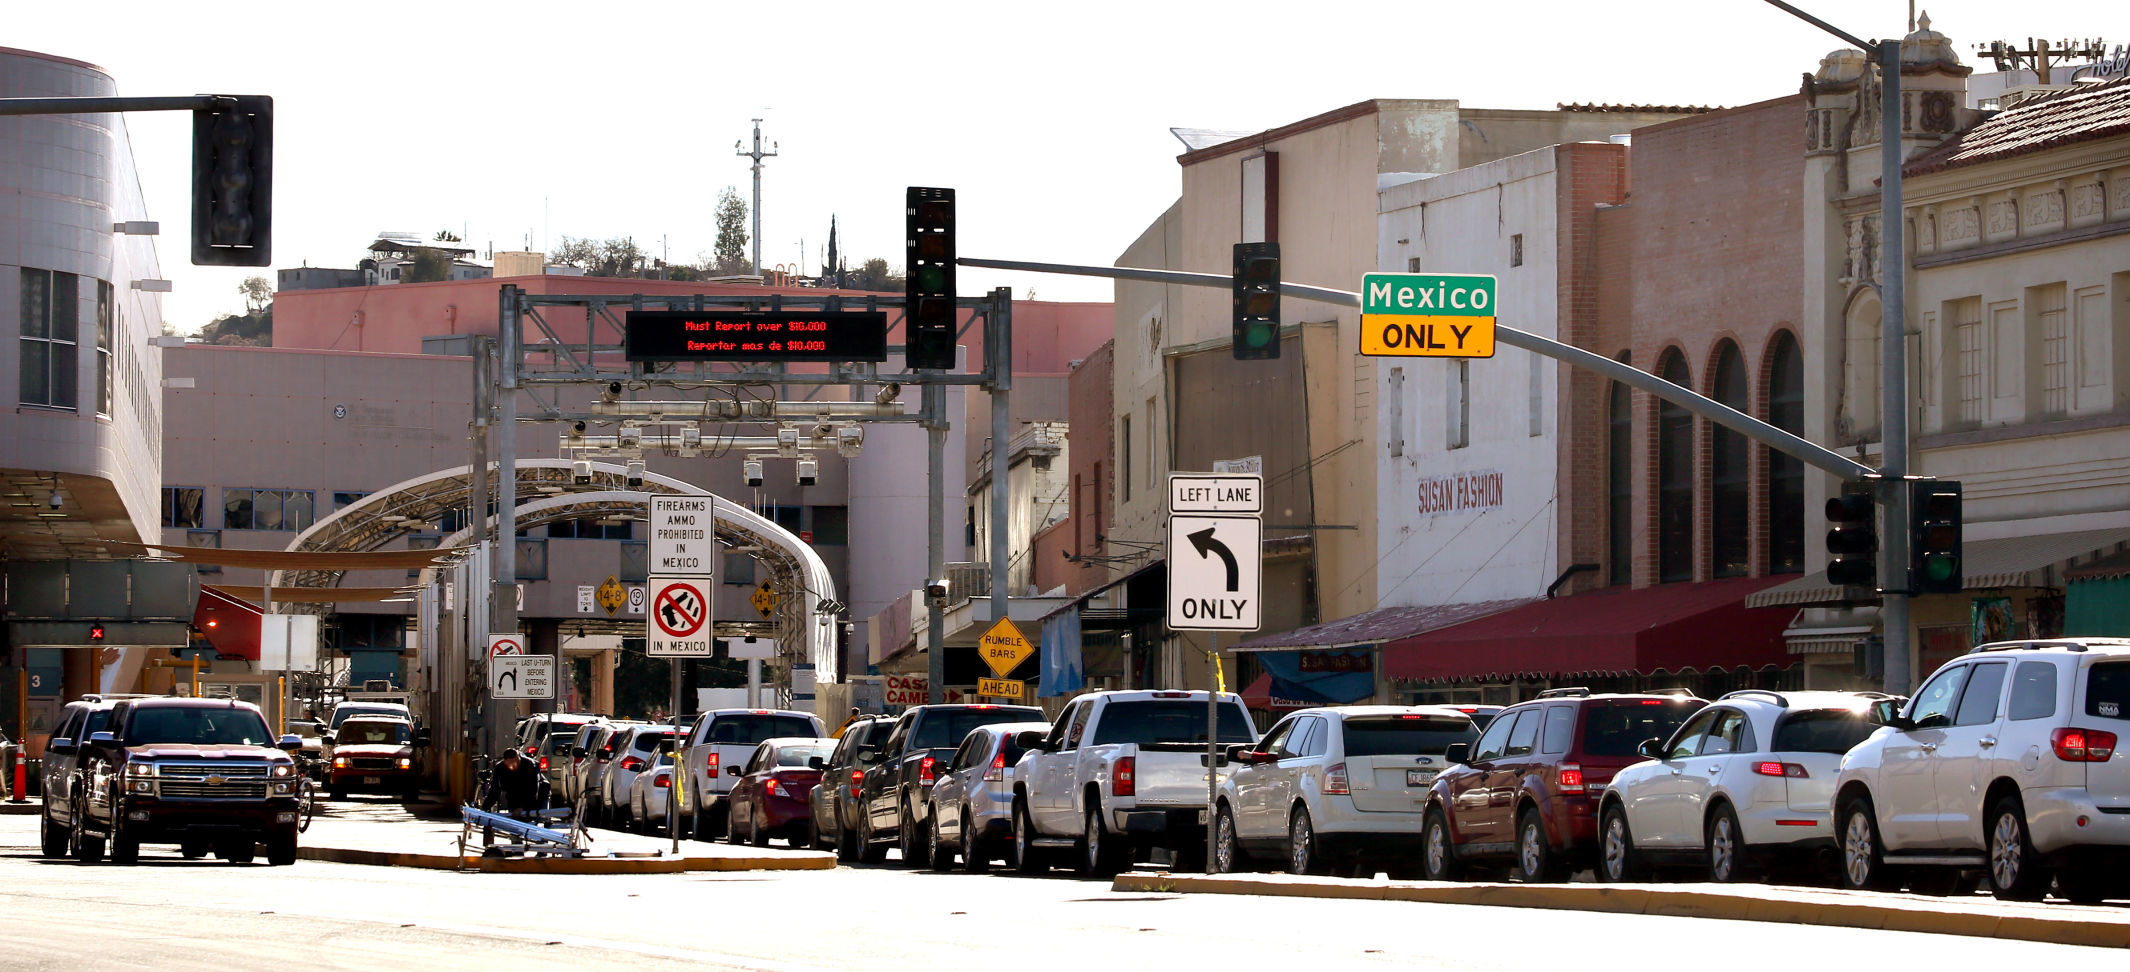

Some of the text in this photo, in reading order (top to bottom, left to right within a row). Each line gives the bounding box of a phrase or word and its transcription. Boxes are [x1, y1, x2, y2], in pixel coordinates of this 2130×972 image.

[1369, 281, 1488, 309] Mexico
[685, 321, 710, 331] Must
[715, 321, 751, 331] Report
[756, 322, 782, 331] over
[1382, 323, 1473, 349] ONLY
[687, 340, 736, 350] Reportar
[742, 342, 763, 350] mas
[769, 340, 782, 350] de
[1180, 487, 1252, 502] LEFT LANE
[1418, 473, 1503, 514] SUSAN FASHION
[657, 501, 705, 511] FIREARMS
[667, 515, 696, 526] AMMO
[658, 529, 704, 540] PROHIBITED
[676, 543, 686, 553] IN
[662, 557, 699, 568] MEXICO
[1182, 598, 1247, 620] ONLY
[653, 641, 706, 651] IN MEXICO
[985, 635, 1022, 647] RUMBLE
[990, 649, 1016, 659] BARS
[32, 675, 41, 688] 3
[982, 682, 1019, 695] AHEAD
